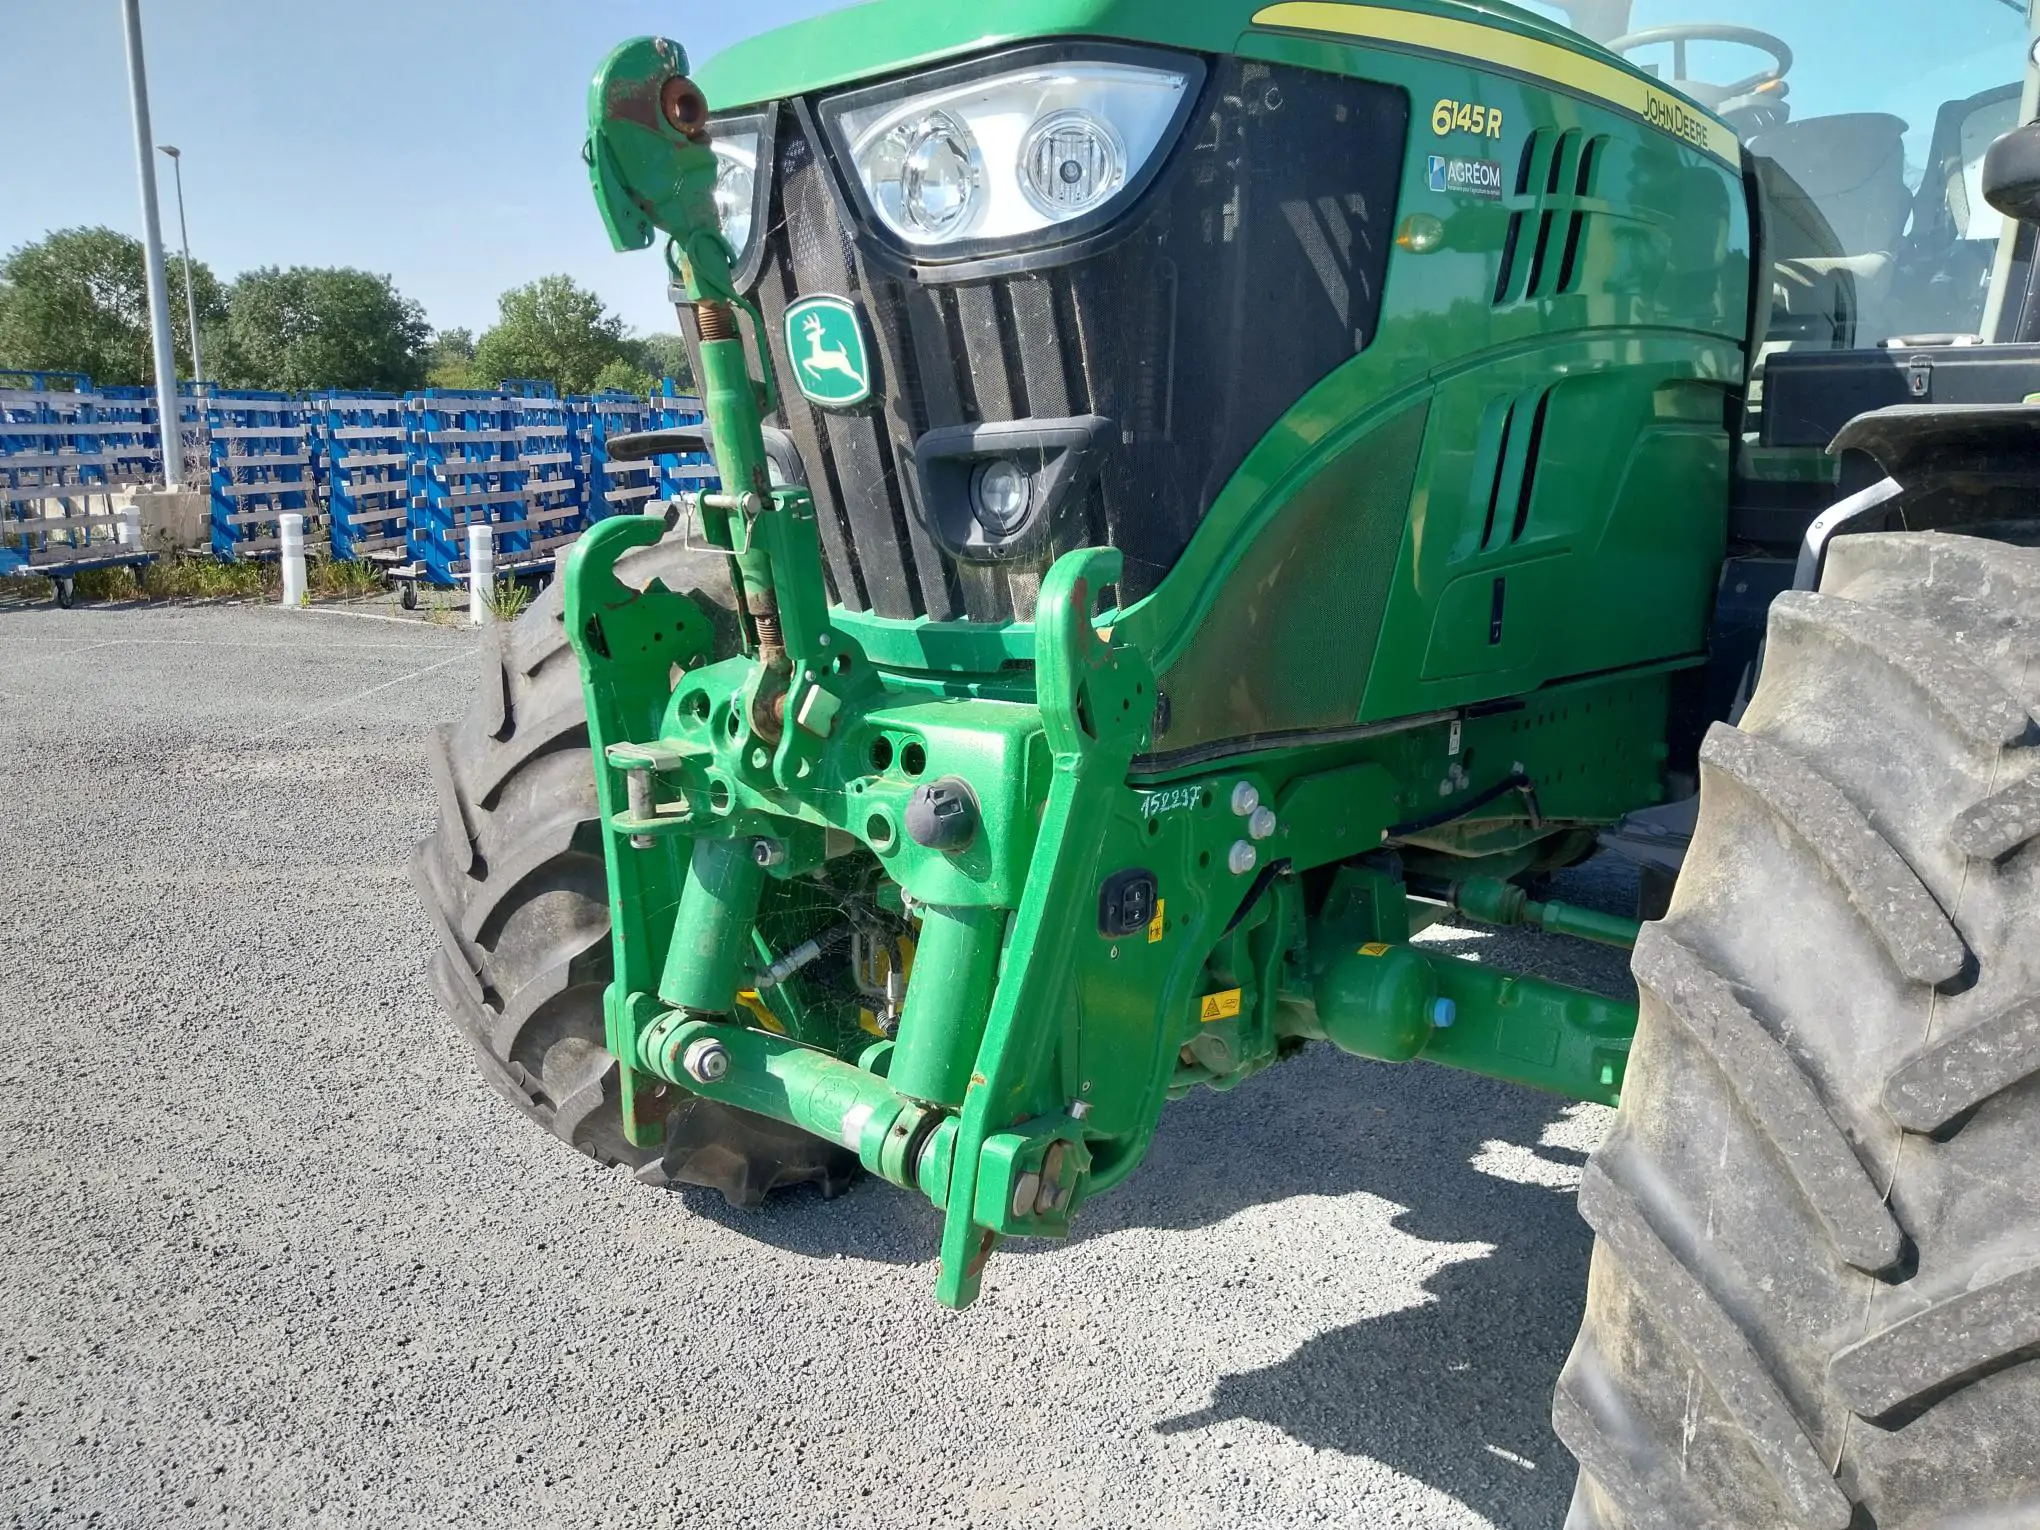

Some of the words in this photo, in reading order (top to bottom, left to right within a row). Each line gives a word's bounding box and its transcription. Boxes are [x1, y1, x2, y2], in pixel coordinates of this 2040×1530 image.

[1643, 90, 1674, 129] JOHN
[1674, 104, 1708, 148] DEERE
[1447, 160, 1501, 187] AGRÉOM
